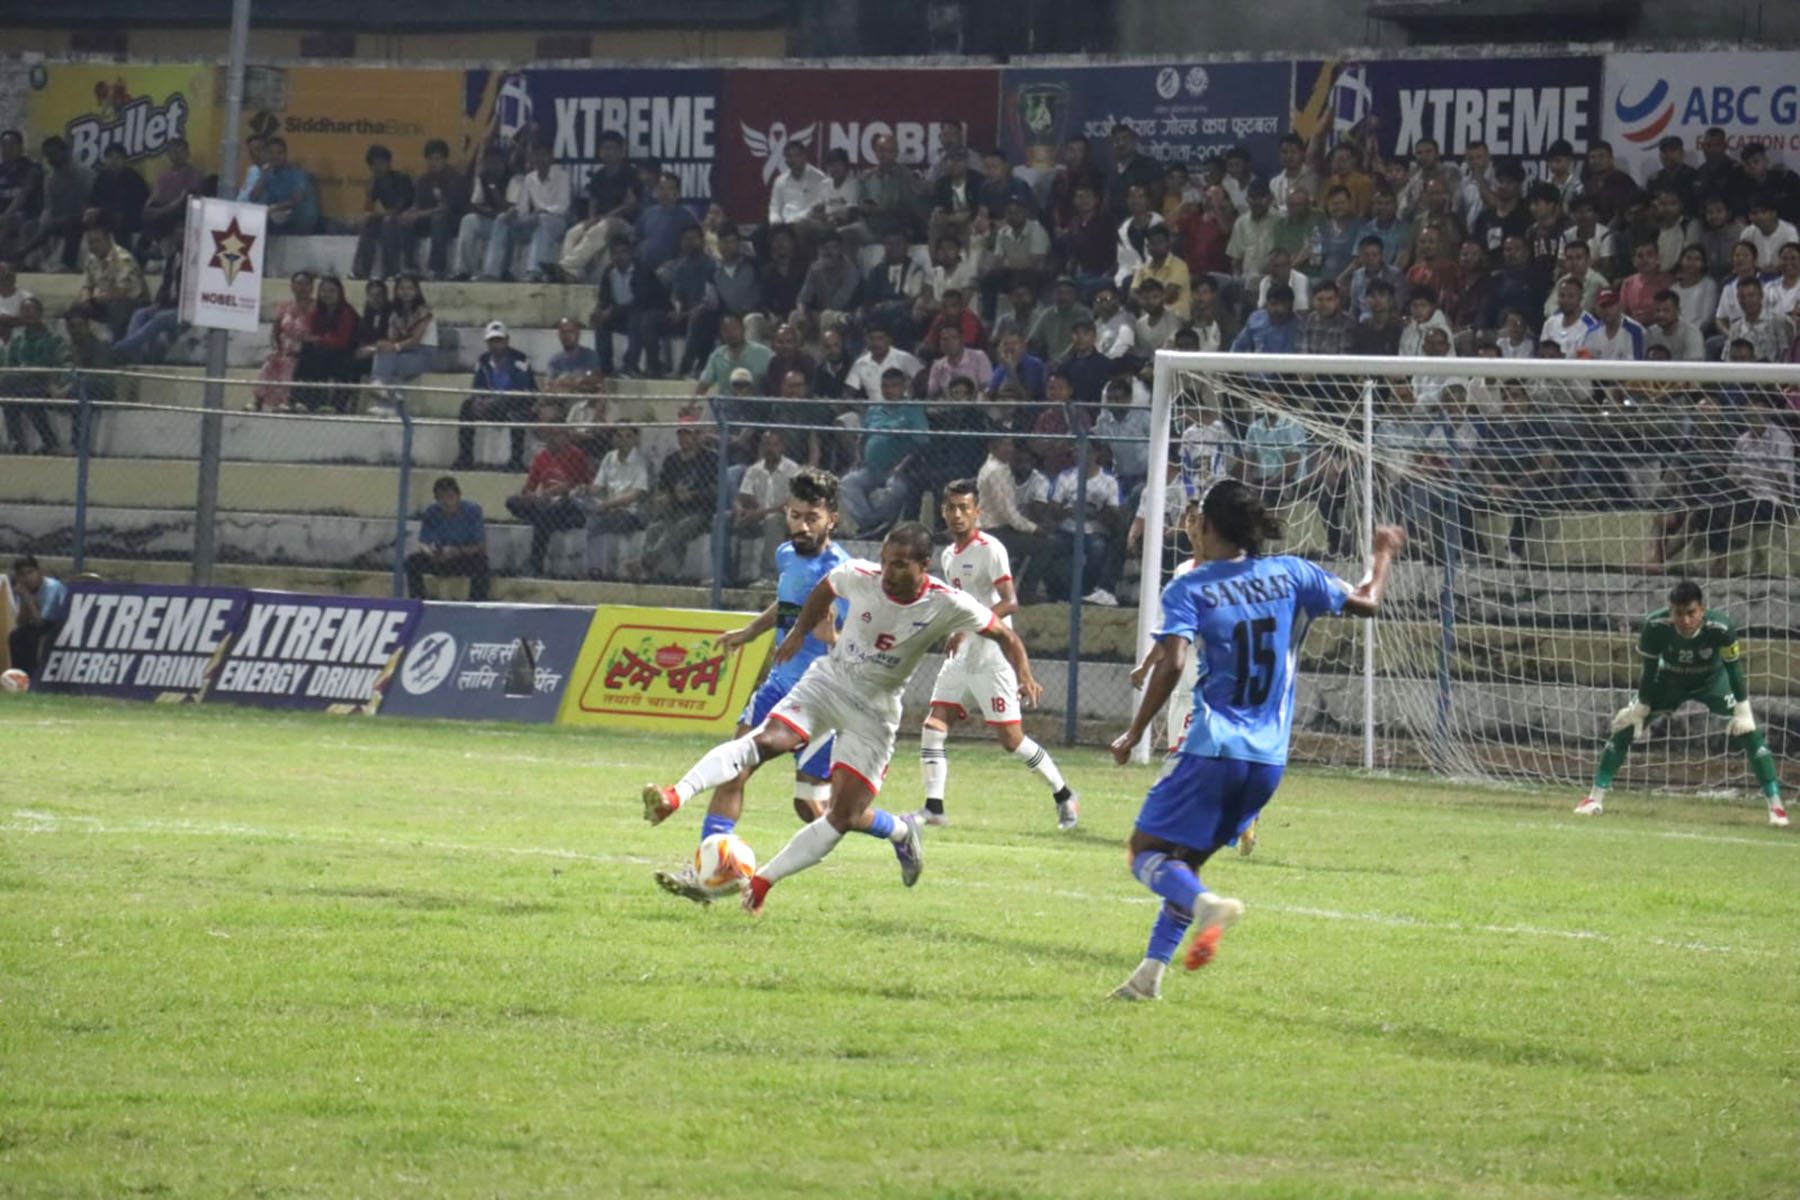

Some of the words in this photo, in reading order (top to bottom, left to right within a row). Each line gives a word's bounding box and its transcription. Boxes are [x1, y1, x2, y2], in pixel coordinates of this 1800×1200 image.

[70, 98, 184, 168] Bullet
[553, 96, 716, 159] XTREME
[1395, 86, 1590, 156] XTREME
[1681, 86, 1761, 126] ABC
[53, 593, 233, 653] XTREME
[231, 603, 408, 665] XTREME
[875, 633, 896, 651] 6
[40, 651, 136, 685] ENERGY
[134, 654, 212, 689] DRINK
[215, 659, 310, 695] ENERGY
[305, 665, 383, 700] DRINK
[1232, 618, 1276, 706] 15
[991, 697, 1006, 713] 18
